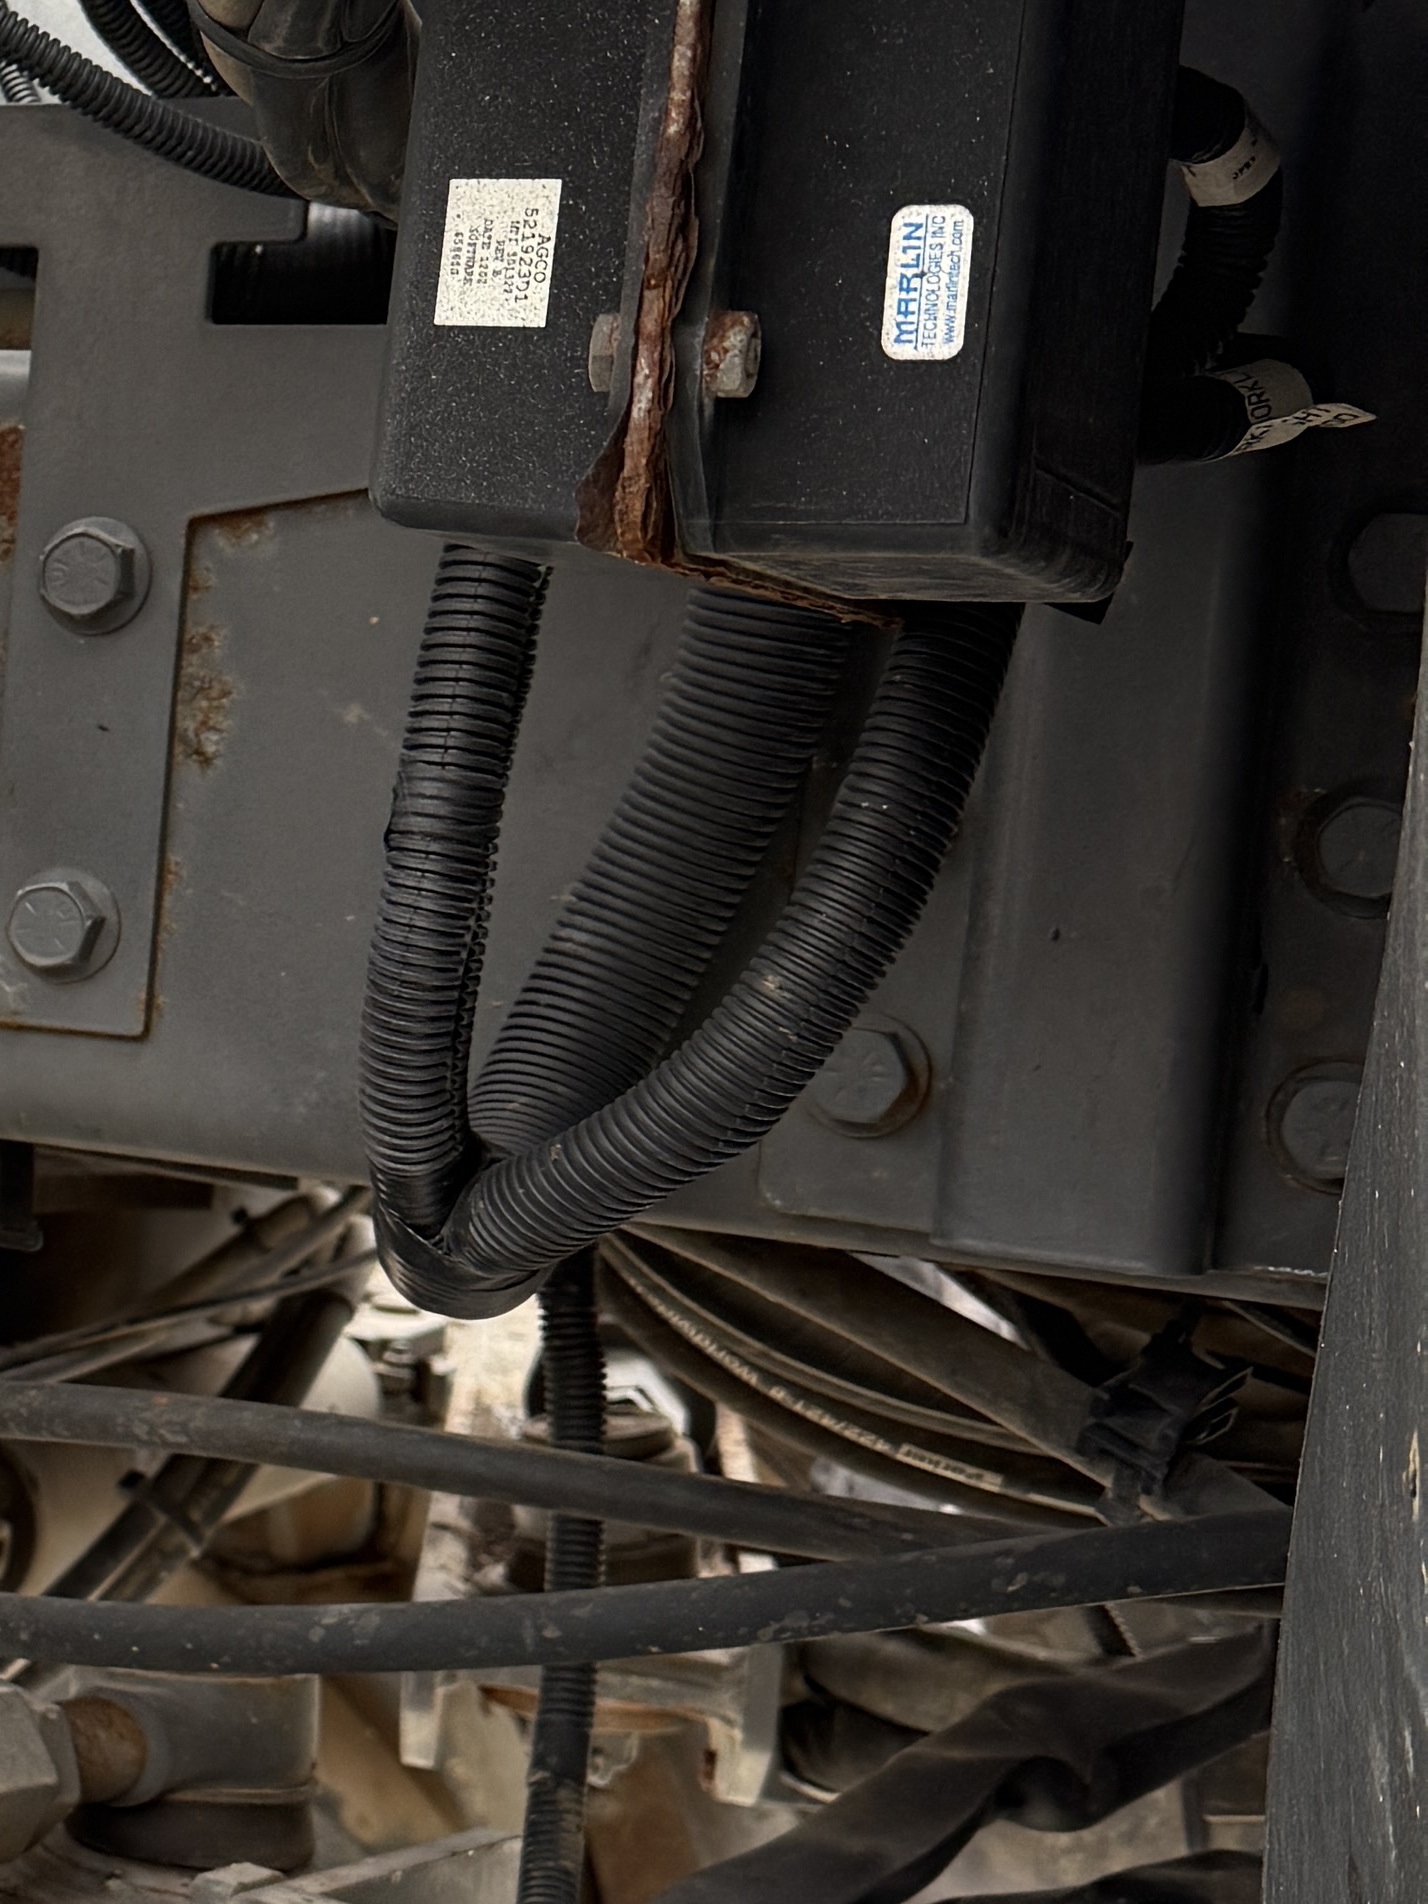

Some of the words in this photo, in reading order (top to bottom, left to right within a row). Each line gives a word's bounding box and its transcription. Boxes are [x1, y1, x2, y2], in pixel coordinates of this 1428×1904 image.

[533, 233, 551, 283] AGCO
[931, 215, 946, 238] INC
[894, 222, 923, 344] MARLIN
[921, 243, 943, 349] TECHNOLOGIES
